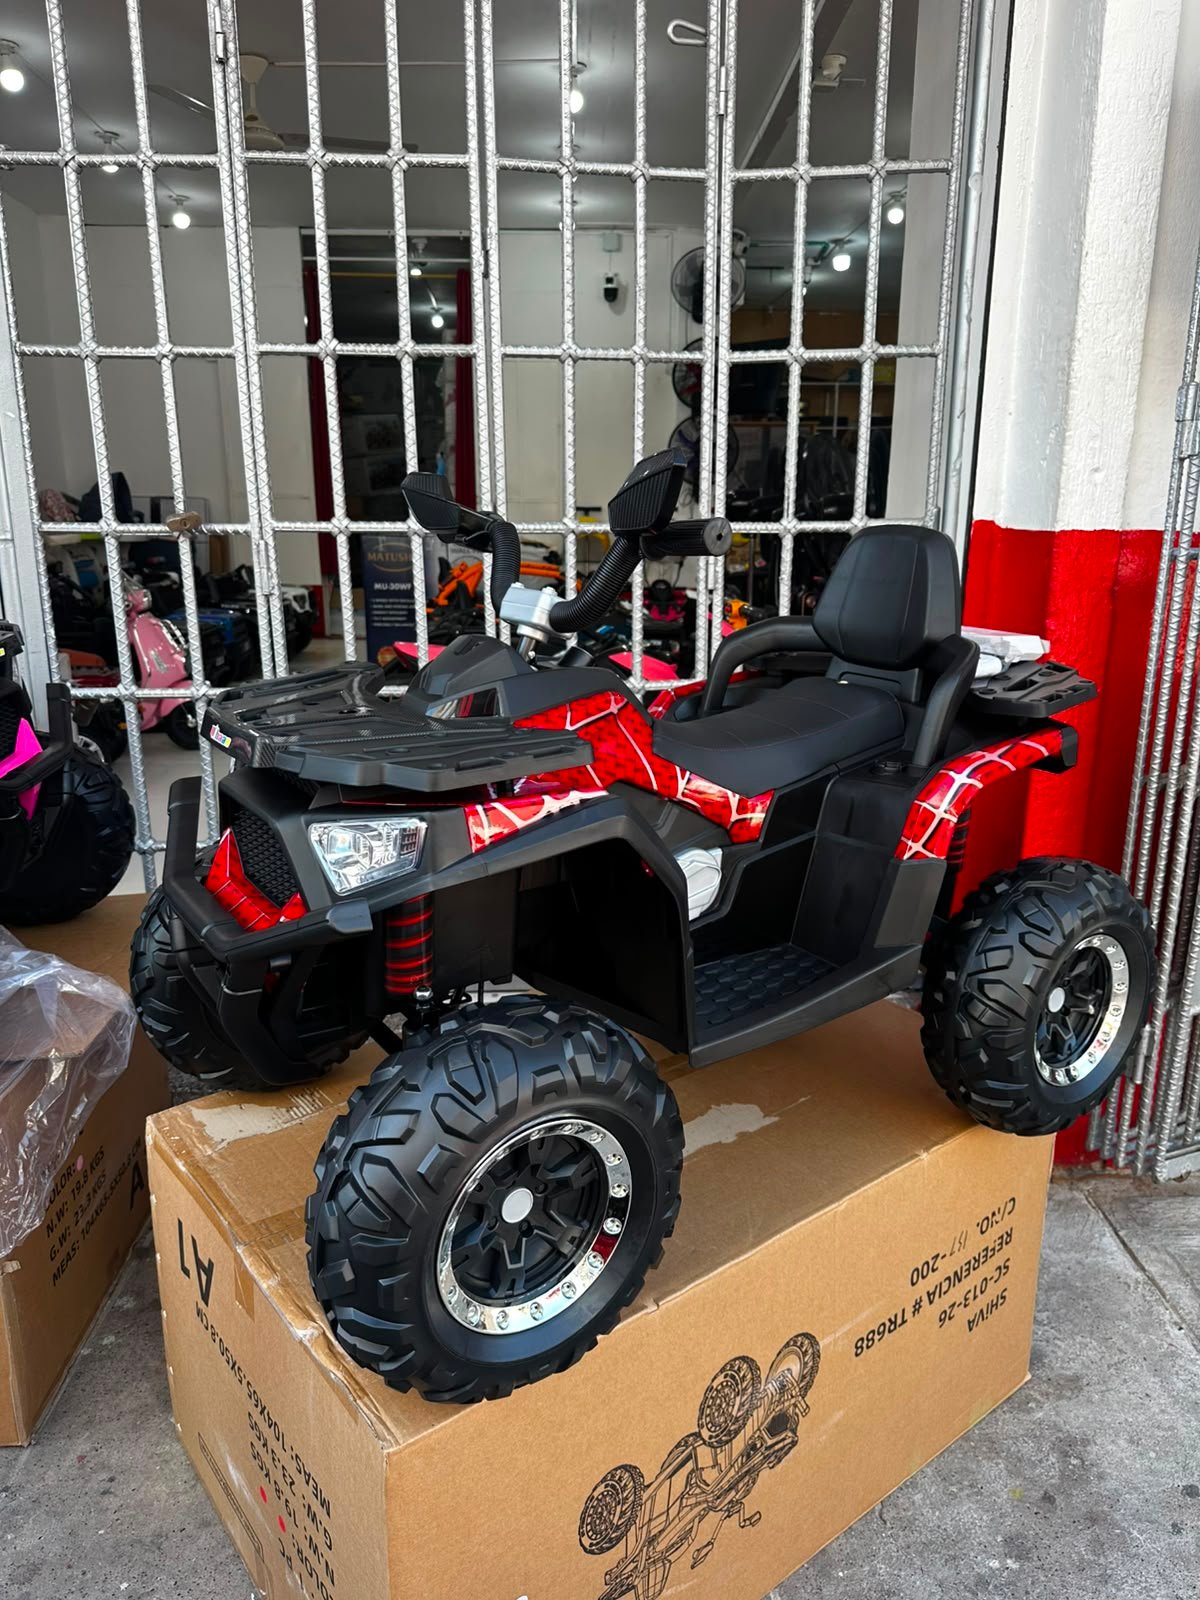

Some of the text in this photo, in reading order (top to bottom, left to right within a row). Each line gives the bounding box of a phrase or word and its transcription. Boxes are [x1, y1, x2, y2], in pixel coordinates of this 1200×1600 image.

[45, 1162, 76, 1212] OLOR:
[71, 1168, 89, 1201] 19.8
[52, 1239, 80, 1287] MEAS:
[177, 1216, 215, 1308] A1
[854, 1226, 1014, 1358] REFERENCIA # TR688
[938, 1257, 1011, 1329] SC-013-26
[247, 1410, 333, 1552] G.W: 23.3 KGS
[250, 1440, 336, 1588] N.W: 19.8 KGS
[290, 1445, 332, 1520] MEAS:
[292, 1533, 334, 1600] OLOR:
